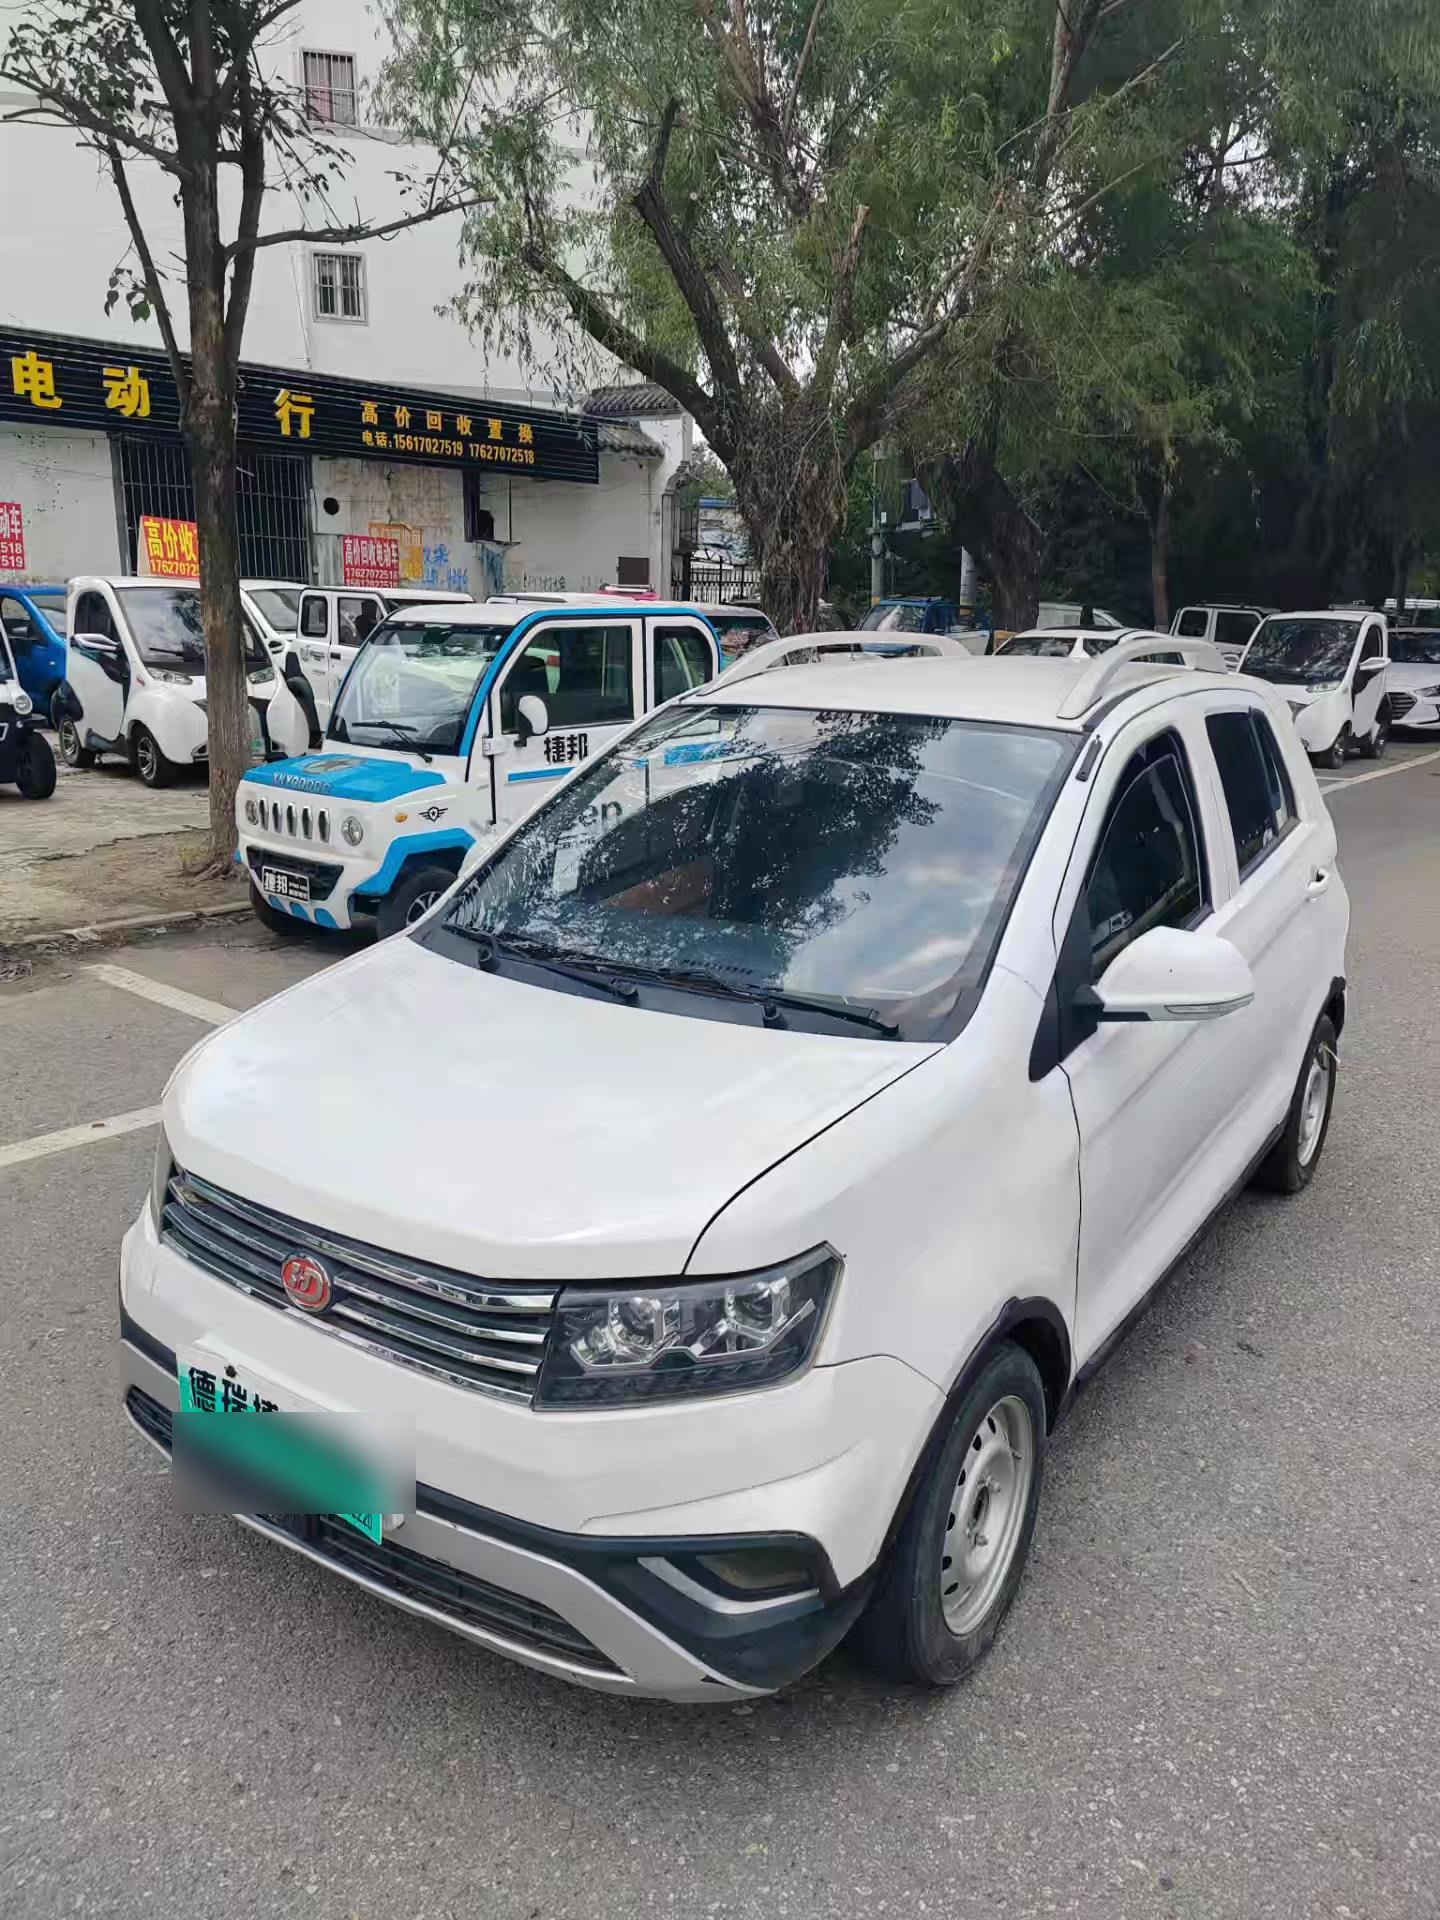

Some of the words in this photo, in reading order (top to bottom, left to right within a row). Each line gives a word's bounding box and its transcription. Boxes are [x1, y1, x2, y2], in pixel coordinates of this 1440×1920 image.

[360, 400, 534, 444] 高价回收置换
[469, 443, 536, 465] 17627072518
[143, 519, 198, 562] 高价收
[544, 733, 588, 763] 捷邦
